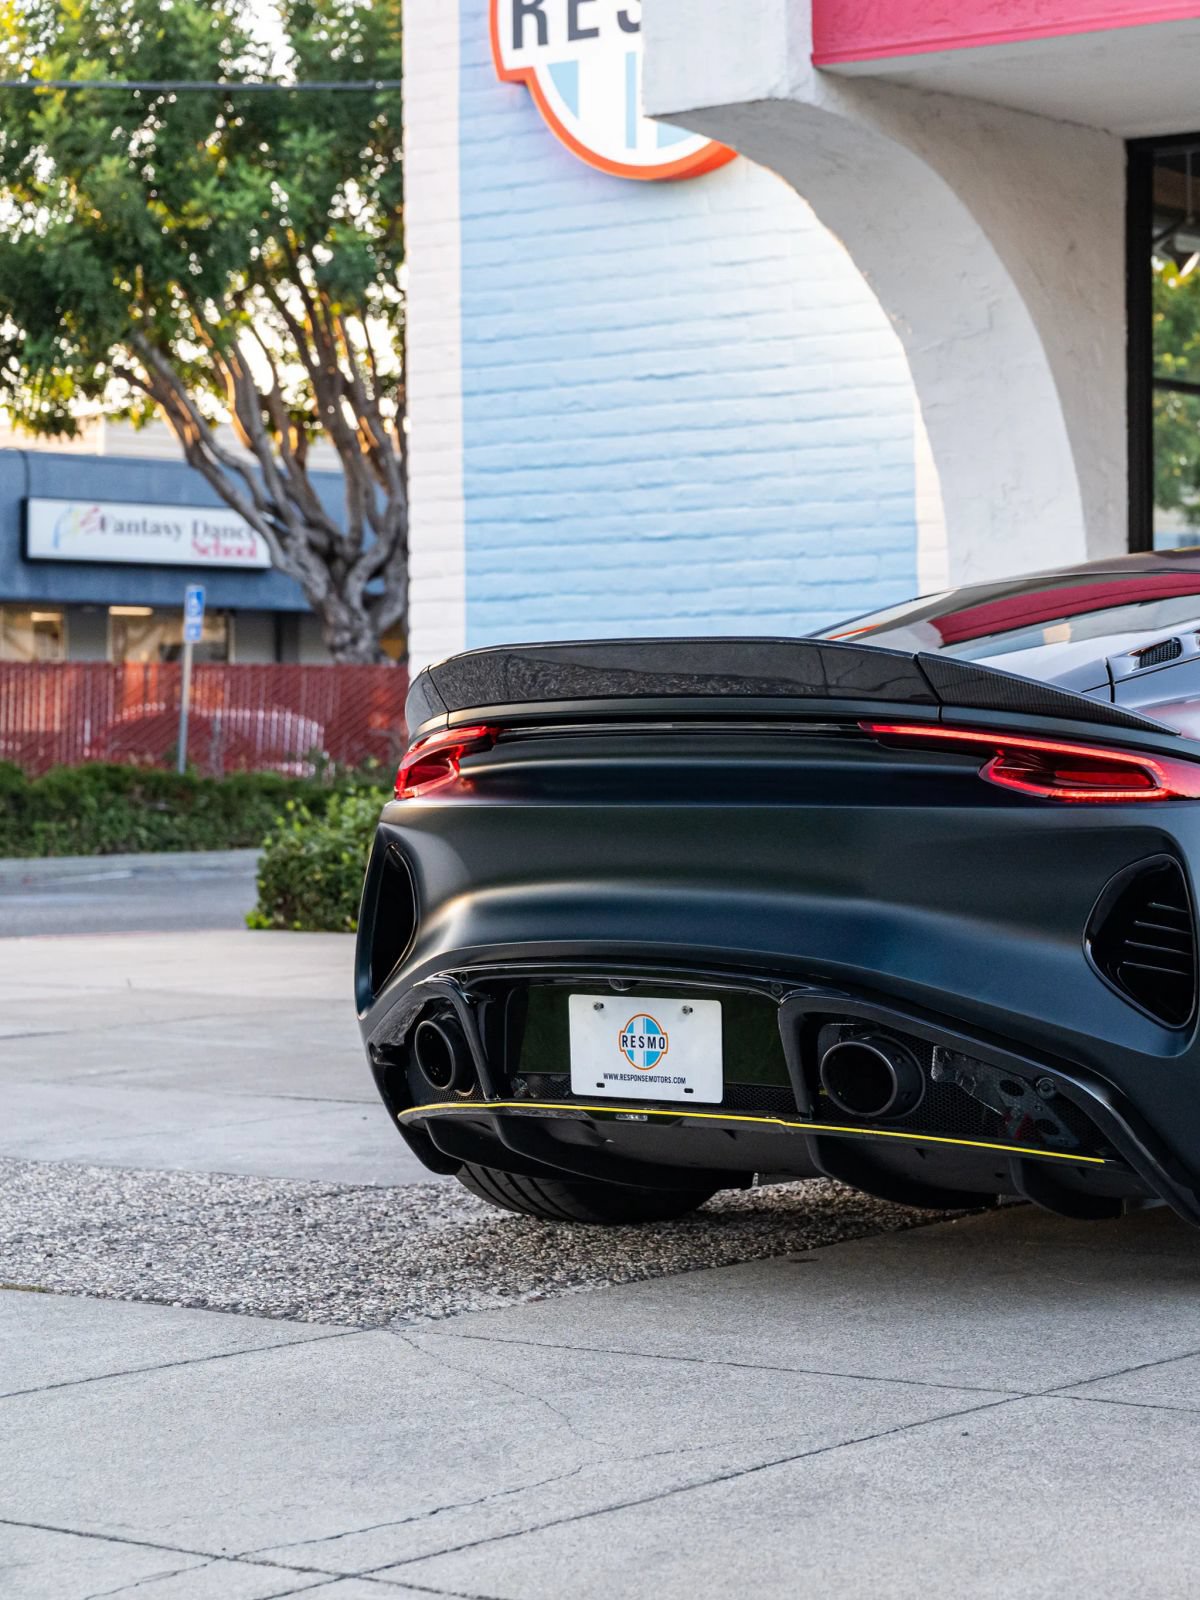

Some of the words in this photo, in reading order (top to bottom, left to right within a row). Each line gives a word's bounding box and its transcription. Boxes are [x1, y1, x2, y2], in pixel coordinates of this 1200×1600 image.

[99, 515, 183, 541] Fantasy
[622, 1035, 665, 1050] RESMO
[603, 1072, 686, 1084] WWW.RESPONSEMOTORS.COM
